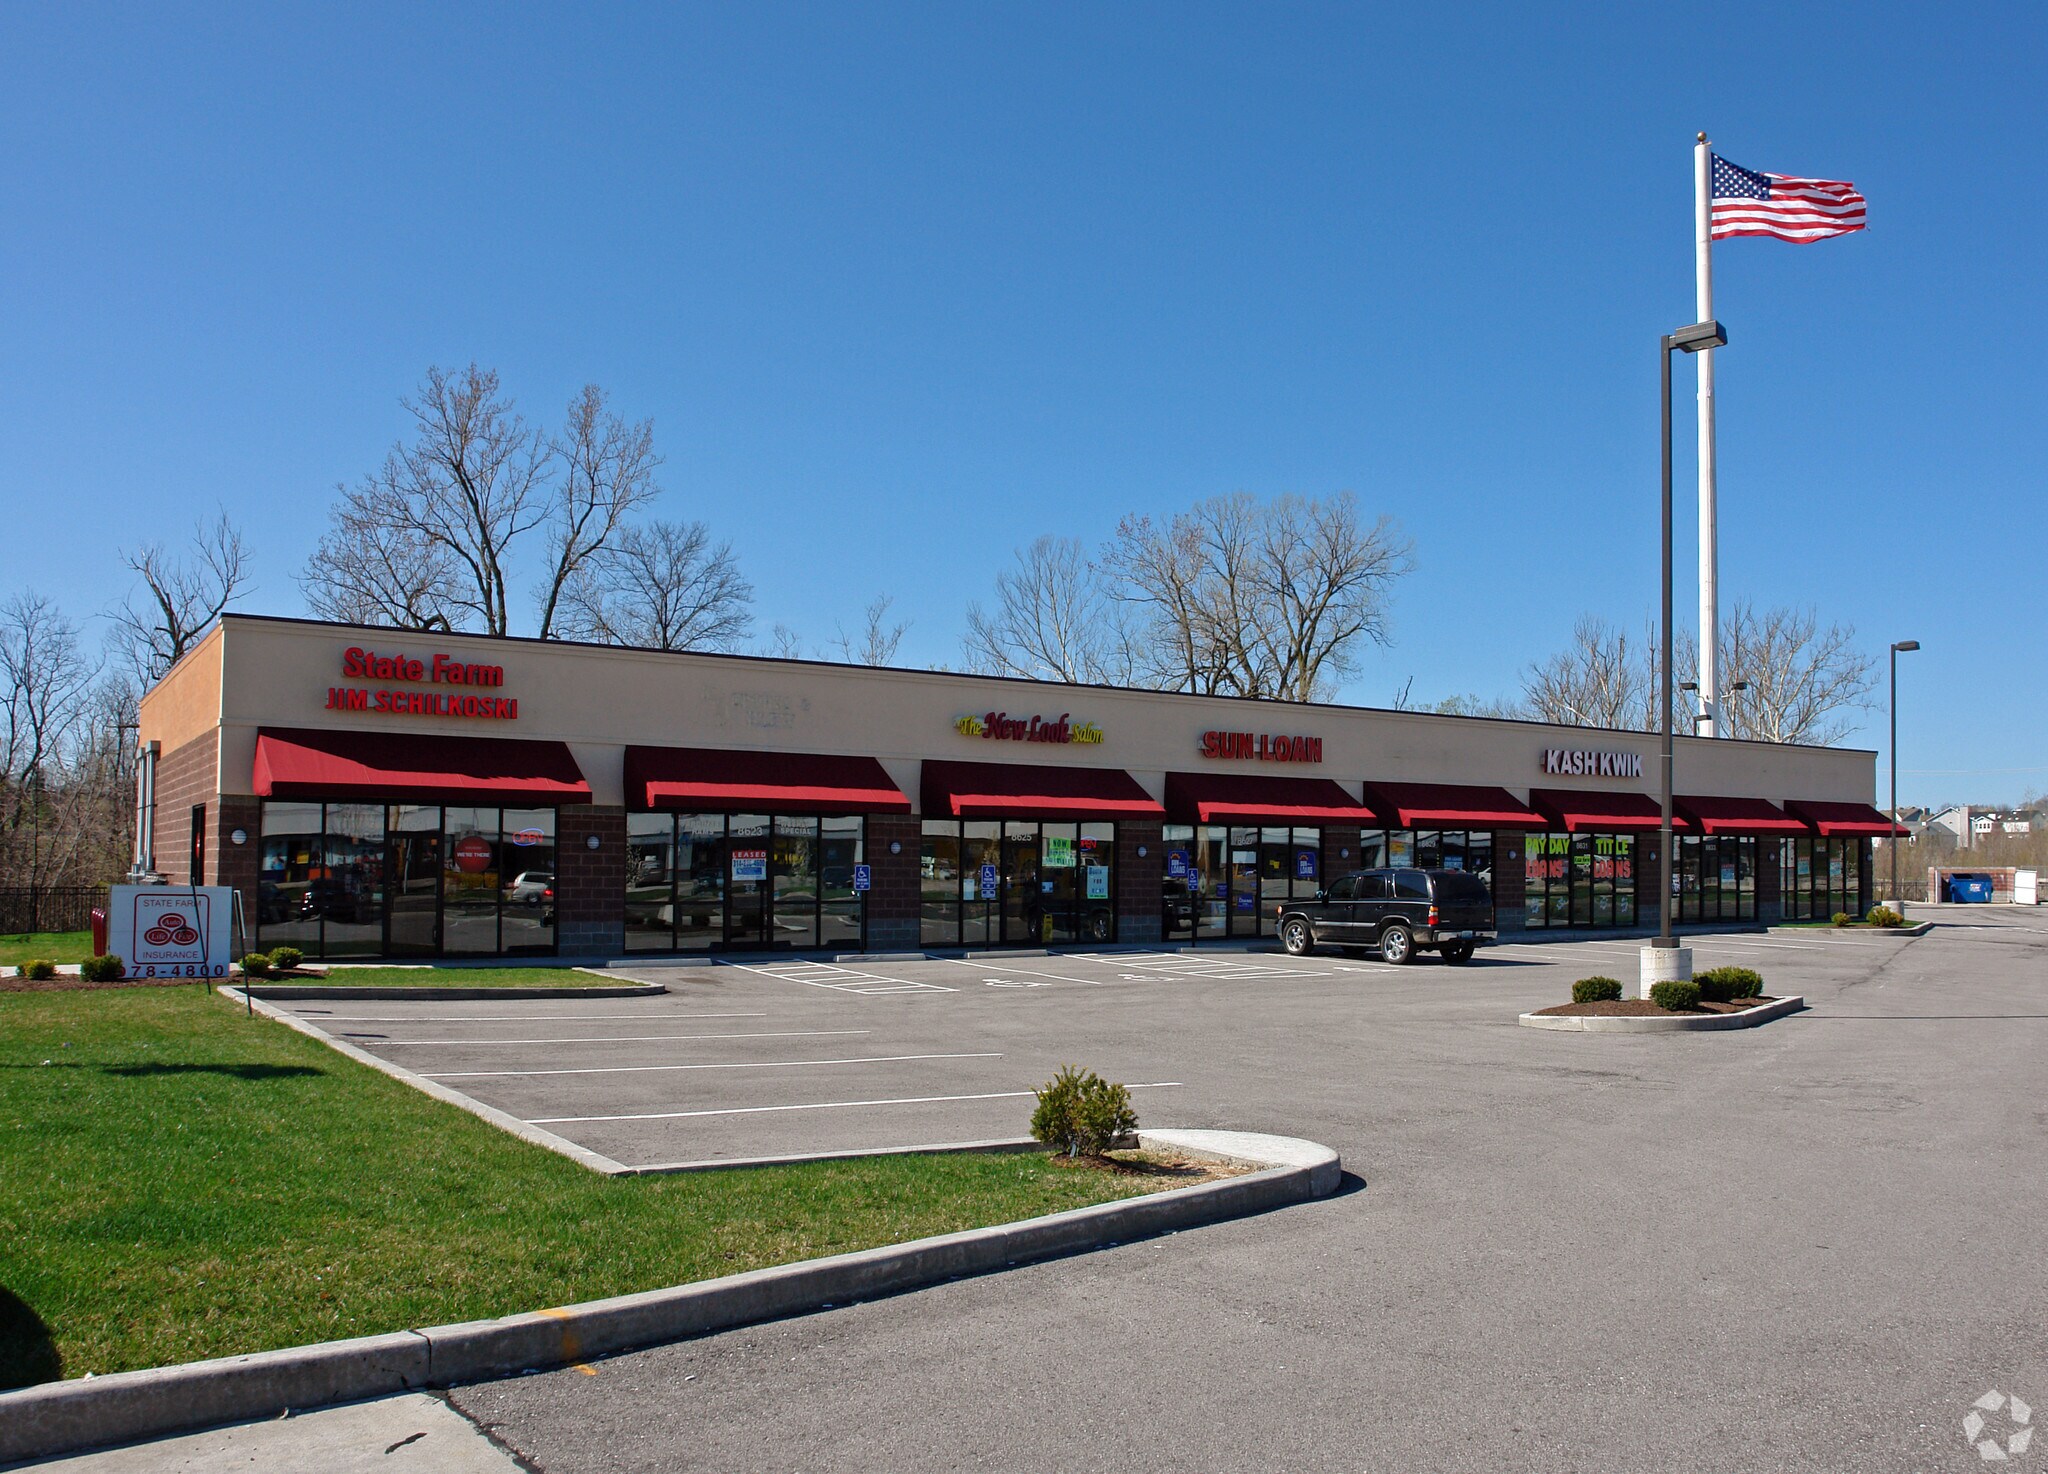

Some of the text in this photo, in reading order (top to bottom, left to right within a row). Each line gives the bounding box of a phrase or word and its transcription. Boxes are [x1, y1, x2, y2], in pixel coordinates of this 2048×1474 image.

[343, 646, 504, 687] State Farm
[325, 687, 518, 720] JIM SCHILKOSKI
[960, 712, 1104, 744] The New Look Salon
[1203, 731, 1322, 763] SUN LOAN
[1545, 749, 1643, 777] KASH KWIK
[512, 832, 543, 842] OPEN
[737, 827, 763, 836] 8623
[143, 899, 172, 907] STATE
[143, 951, 198, 959] INSURANCE
